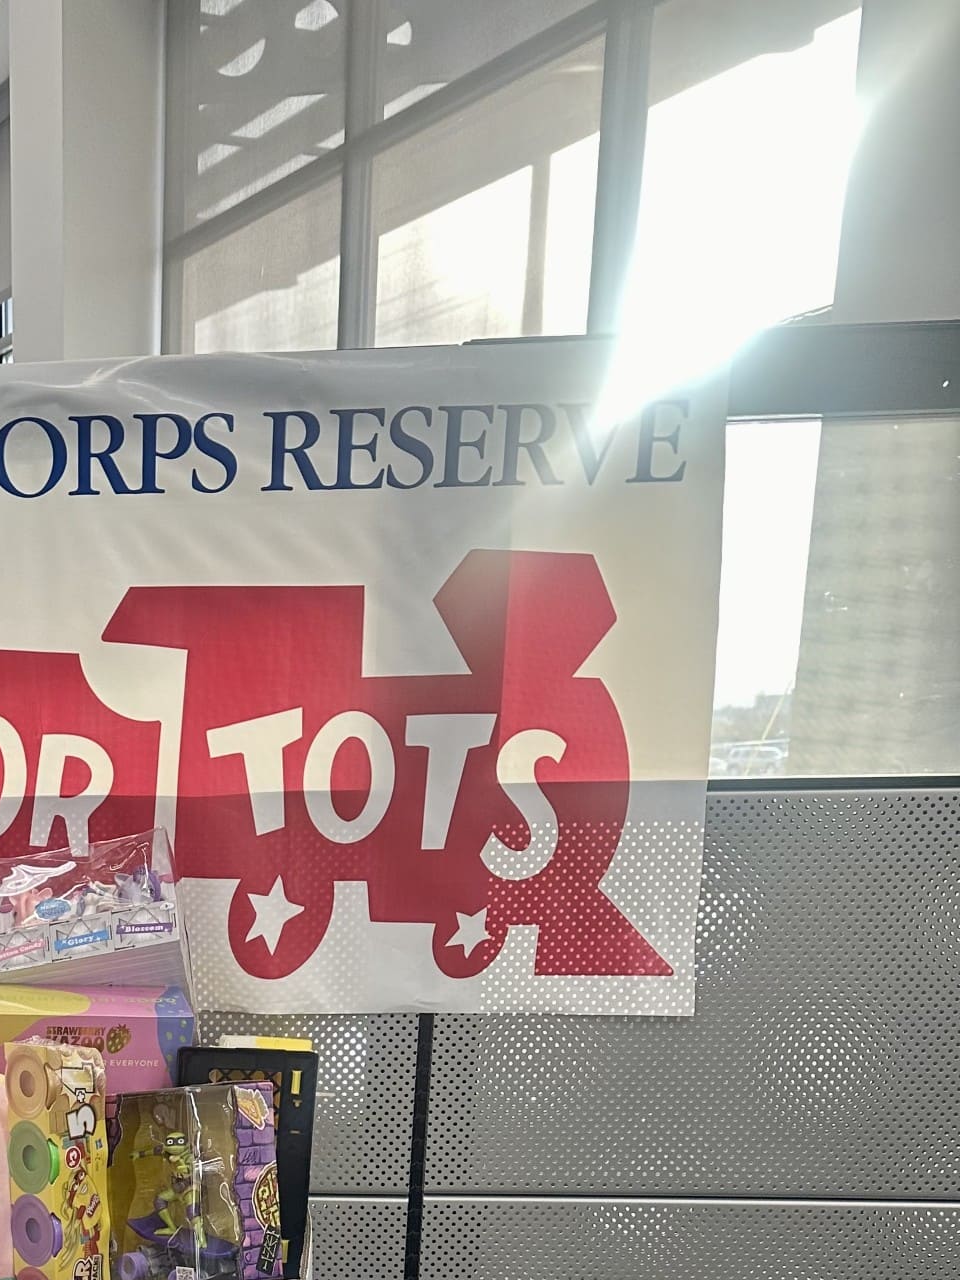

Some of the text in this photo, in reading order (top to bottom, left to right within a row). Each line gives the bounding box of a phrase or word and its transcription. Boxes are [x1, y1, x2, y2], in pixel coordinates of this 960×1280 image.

[261, 399, 691, 492] RESERVE
[206, 707, 568, 880] TOTS
[110, 1059, 159, 1067] EVERYONE
